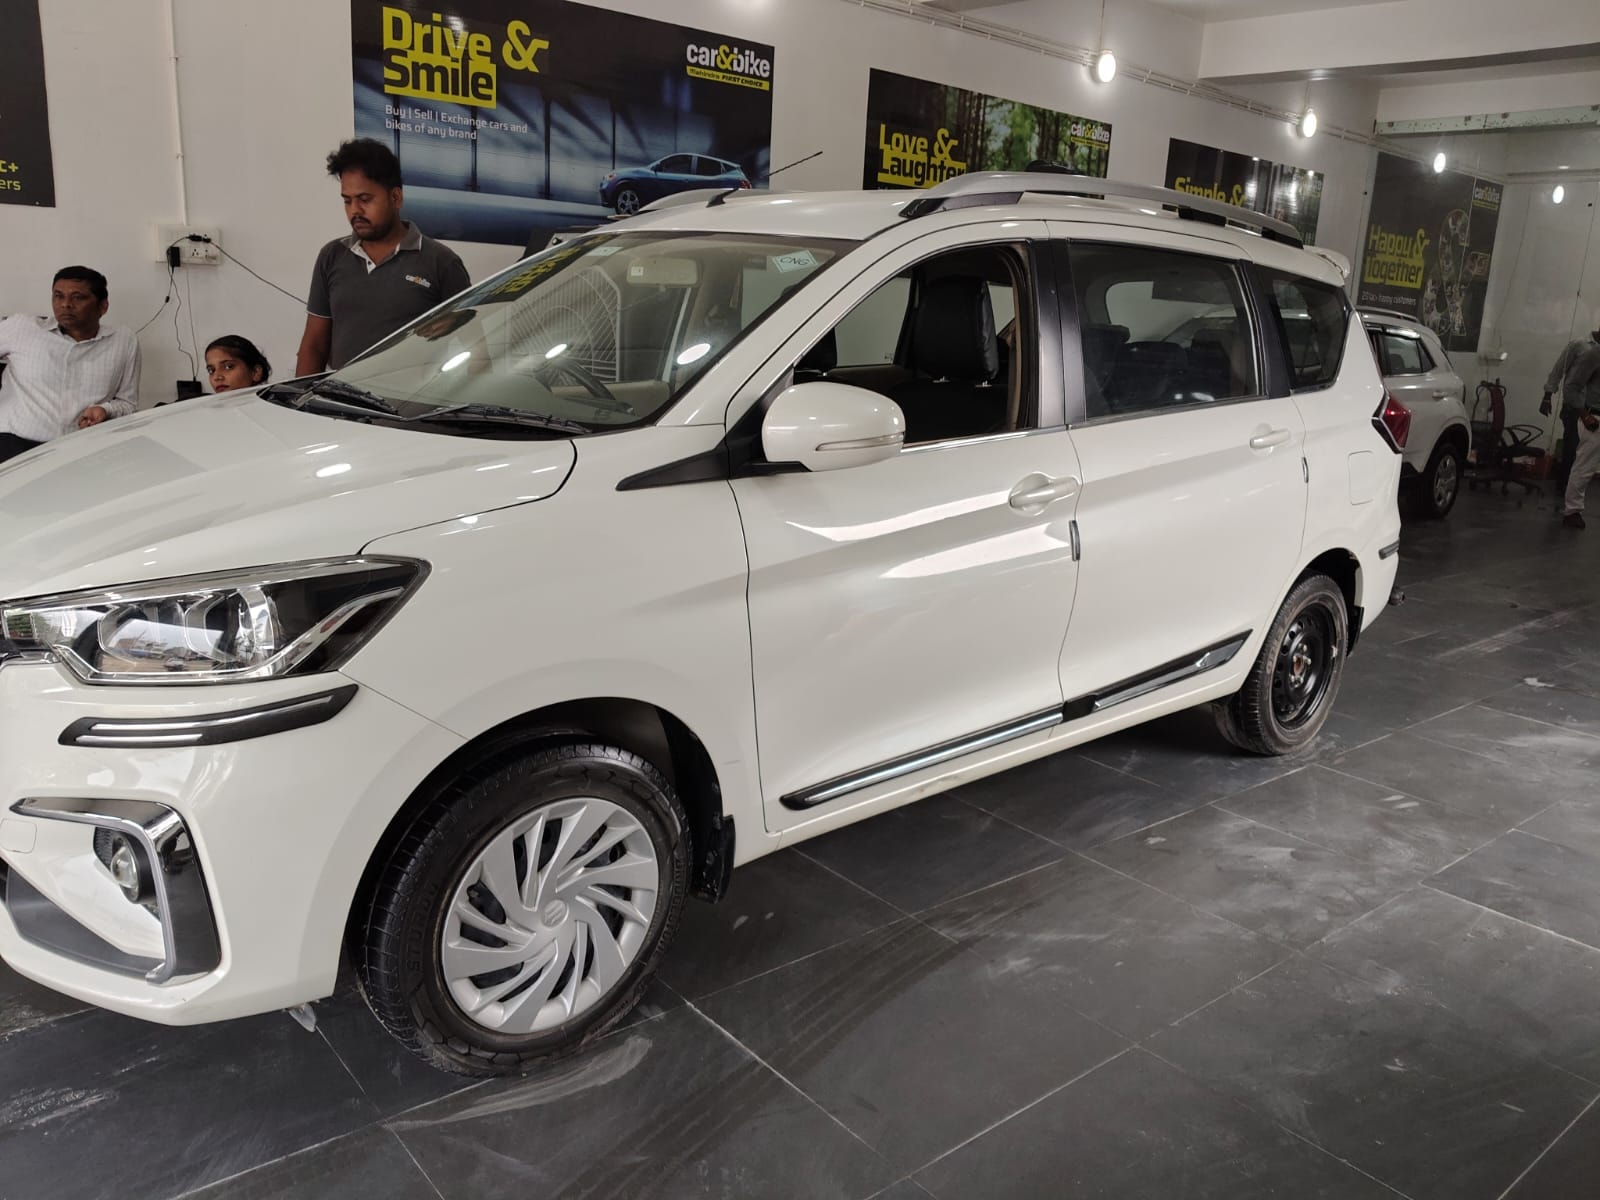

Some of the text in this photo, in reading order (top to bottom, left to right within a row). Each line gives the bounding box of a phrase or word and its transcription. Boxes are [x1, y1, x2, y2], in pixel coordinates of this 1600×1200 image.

[382, 6, 549, 72] Drive &
[384, 48, 494, 101] Smile
[686, 44, 771, 78] car&bike
[721, 74, 741, 83] FIRST
[741, 77, 764, 88] CHOICE
[385, 104, 406, 119] Buy
[414, 108, 433, 120] Sell
[441, 112, 487, 129] Exchange
[489, 120, 508, 131] cars
[510, 123, 528, 134] and
[385, 118, 477, 140] bikes of any brand
[880, 123, 958, 162] Love &
[1367, 224, 1431, 259] Happy &
[1365, 255, 1422, 285] Together
